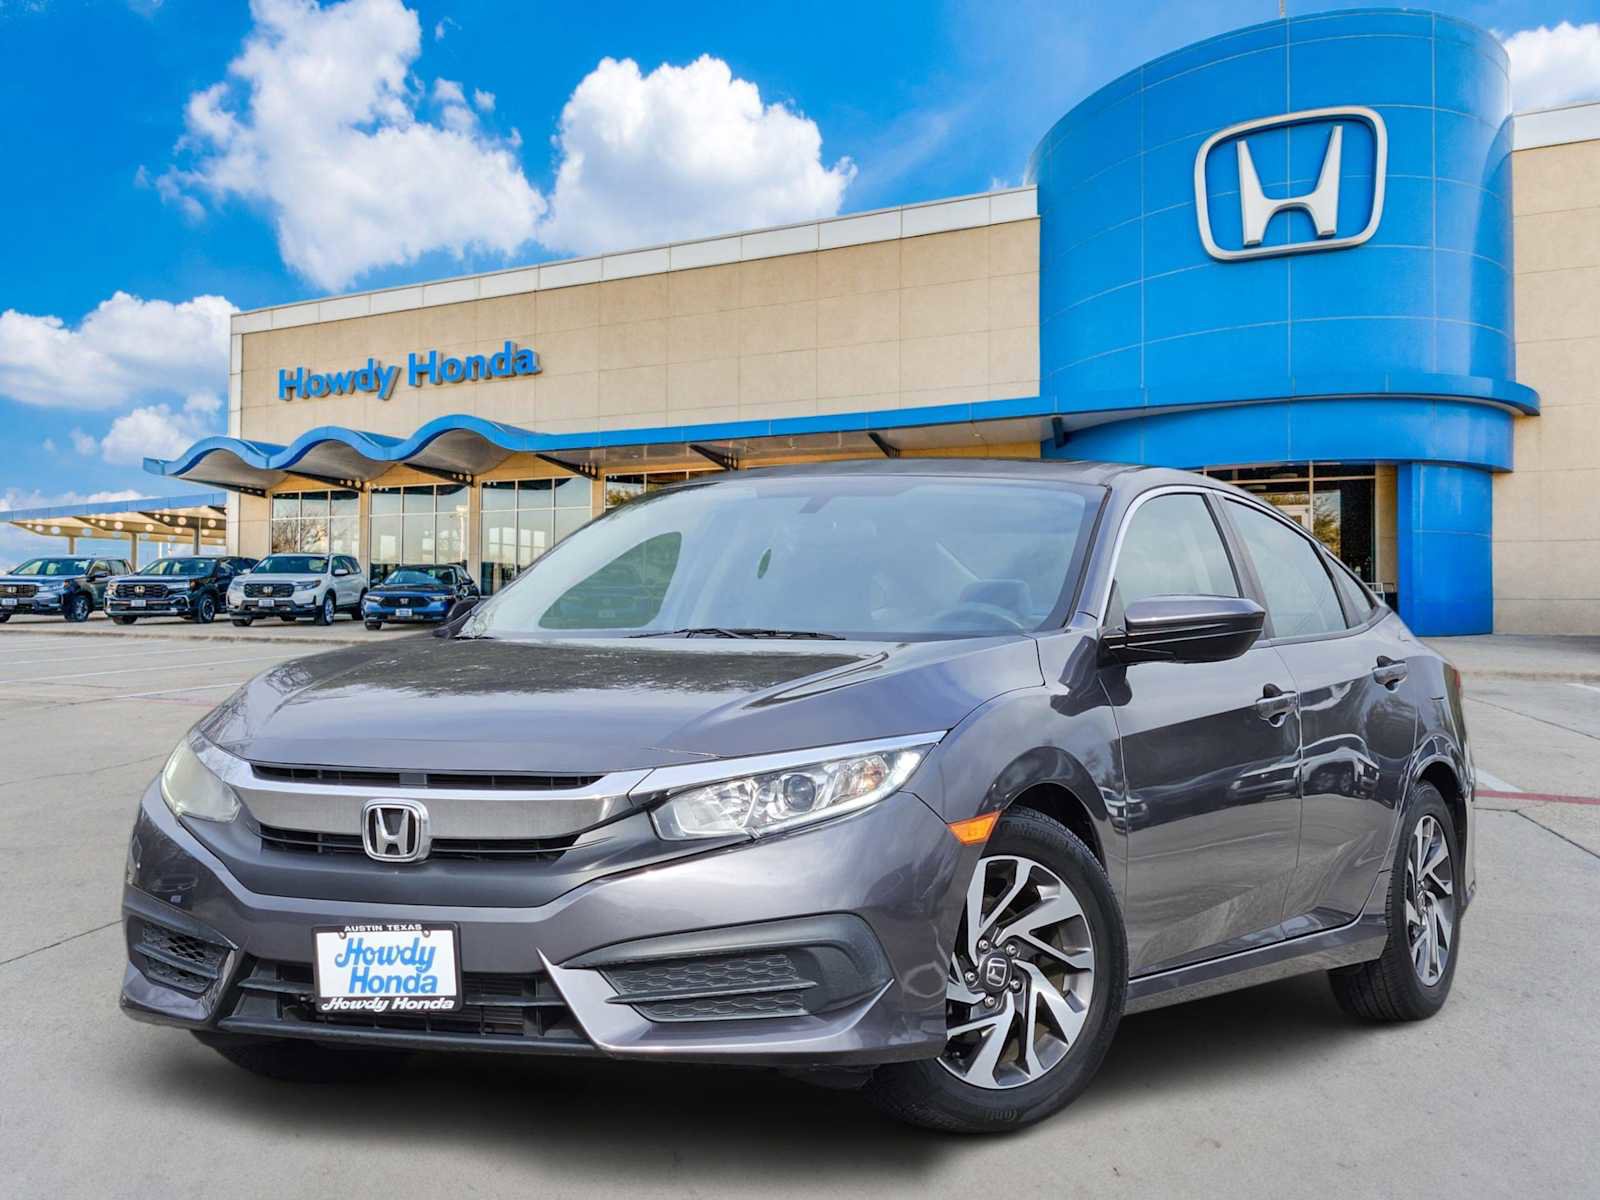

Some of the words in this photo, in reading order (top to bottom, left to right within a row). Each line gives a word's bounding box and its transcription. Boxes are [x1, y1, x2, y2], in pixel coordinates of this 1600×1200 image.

[278, 357, 401, 401] Howdy
[408, 340, 542, 387] Honda
[344, 924, 383, 932] AUSTIN
[386, 923, 423, 932] TEXAS
[334, 937, 437, 973] Howdy
[349, 966, 438, 993] Honda
[321, 997, 388, 1012] Howdy
[391, 997, 455, 1010] Honda
